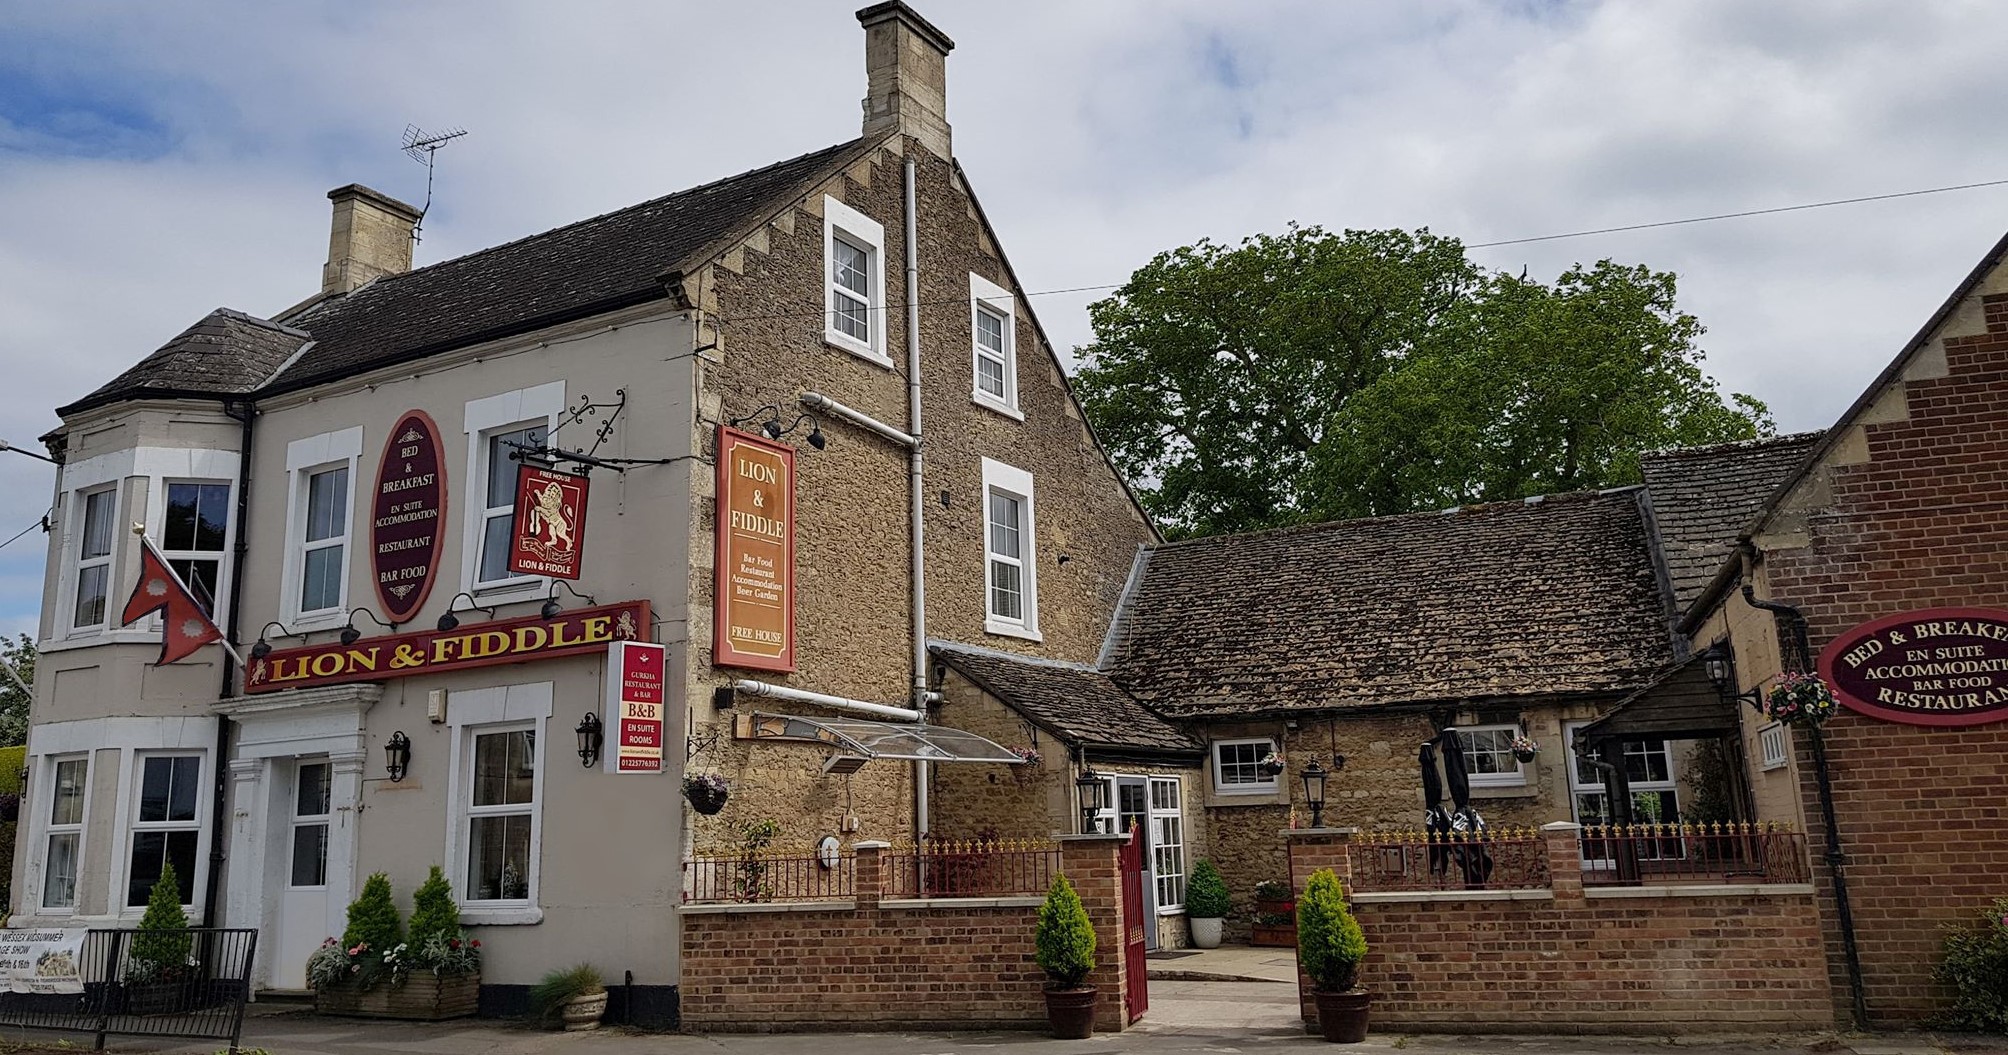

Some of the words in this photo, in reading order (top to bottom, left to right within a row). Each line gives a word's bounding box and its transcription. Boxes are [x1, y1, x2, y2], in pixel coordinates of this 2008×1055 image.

[401, 445, 418, 458] BED
[404, 463, 412, 473] &
[540, 470, 553, 480] FREE
[554, 473, 572, 482] HOUSE
[739, 458, 776, 485] LION
[382, 474, 435, 494] BREAKFAST
[390, 503, 400, 514] EN
[403, 500, 423, 512] SUITE
[752, 490, 764, 508] &
[375, 508, 438, 528] ACCOMMODATION
[731, 510, 784, 539] FIDDLE
[379, 536, 431, 554] RESTAURANT
[518, 559, 537, 570] LION
[538, 562, 544, 570] &
[545, 563, 572, 574] FIDDLE
[743, 553, 756, 564] Bar
[757, 556, 773, 568] Food
[380, 568, 398, 583] BAR
[401, 565, 426, 579] FOOD
[740, 564, 775, 579] Restaurant
[731, 574, 782, 592] Accommodation
[736, 586, 752, 598] Beer
[754, 588, 778, 602] Garden
[732, 626, 752, 639] FREE
[755, 629, 782, 643] HOUSE
[268, 646, 381, 682] LION
[388, 644, 426, 669] &
[431, 616, 612, 664] FIDDLE
[1843, 638, 1883, 668] BED
[1889, 630, 1908, 646] &
[1906, 649, 1929, 662] EN
[1935, 644, 1985, 660] SUITE
[631, 672, 656, 680] GURKHA
[1865, 658, 2008, 681] ACCOMMODATI
[624, 680, 662, 690] RESTAURANT
[1912, 679, 1943, 692] BAR
[1949, 676, 1992, 689] FOOD
[628, 704, 655, 718] B&B
[628, 723, 636, 732] EN
[637, 724, 655, 733] SUITE
[629, 736, 652, 744] ROOMS
[2, 932, 27, 942] WESSEX
[11, 946, 30, 954] SHOW
